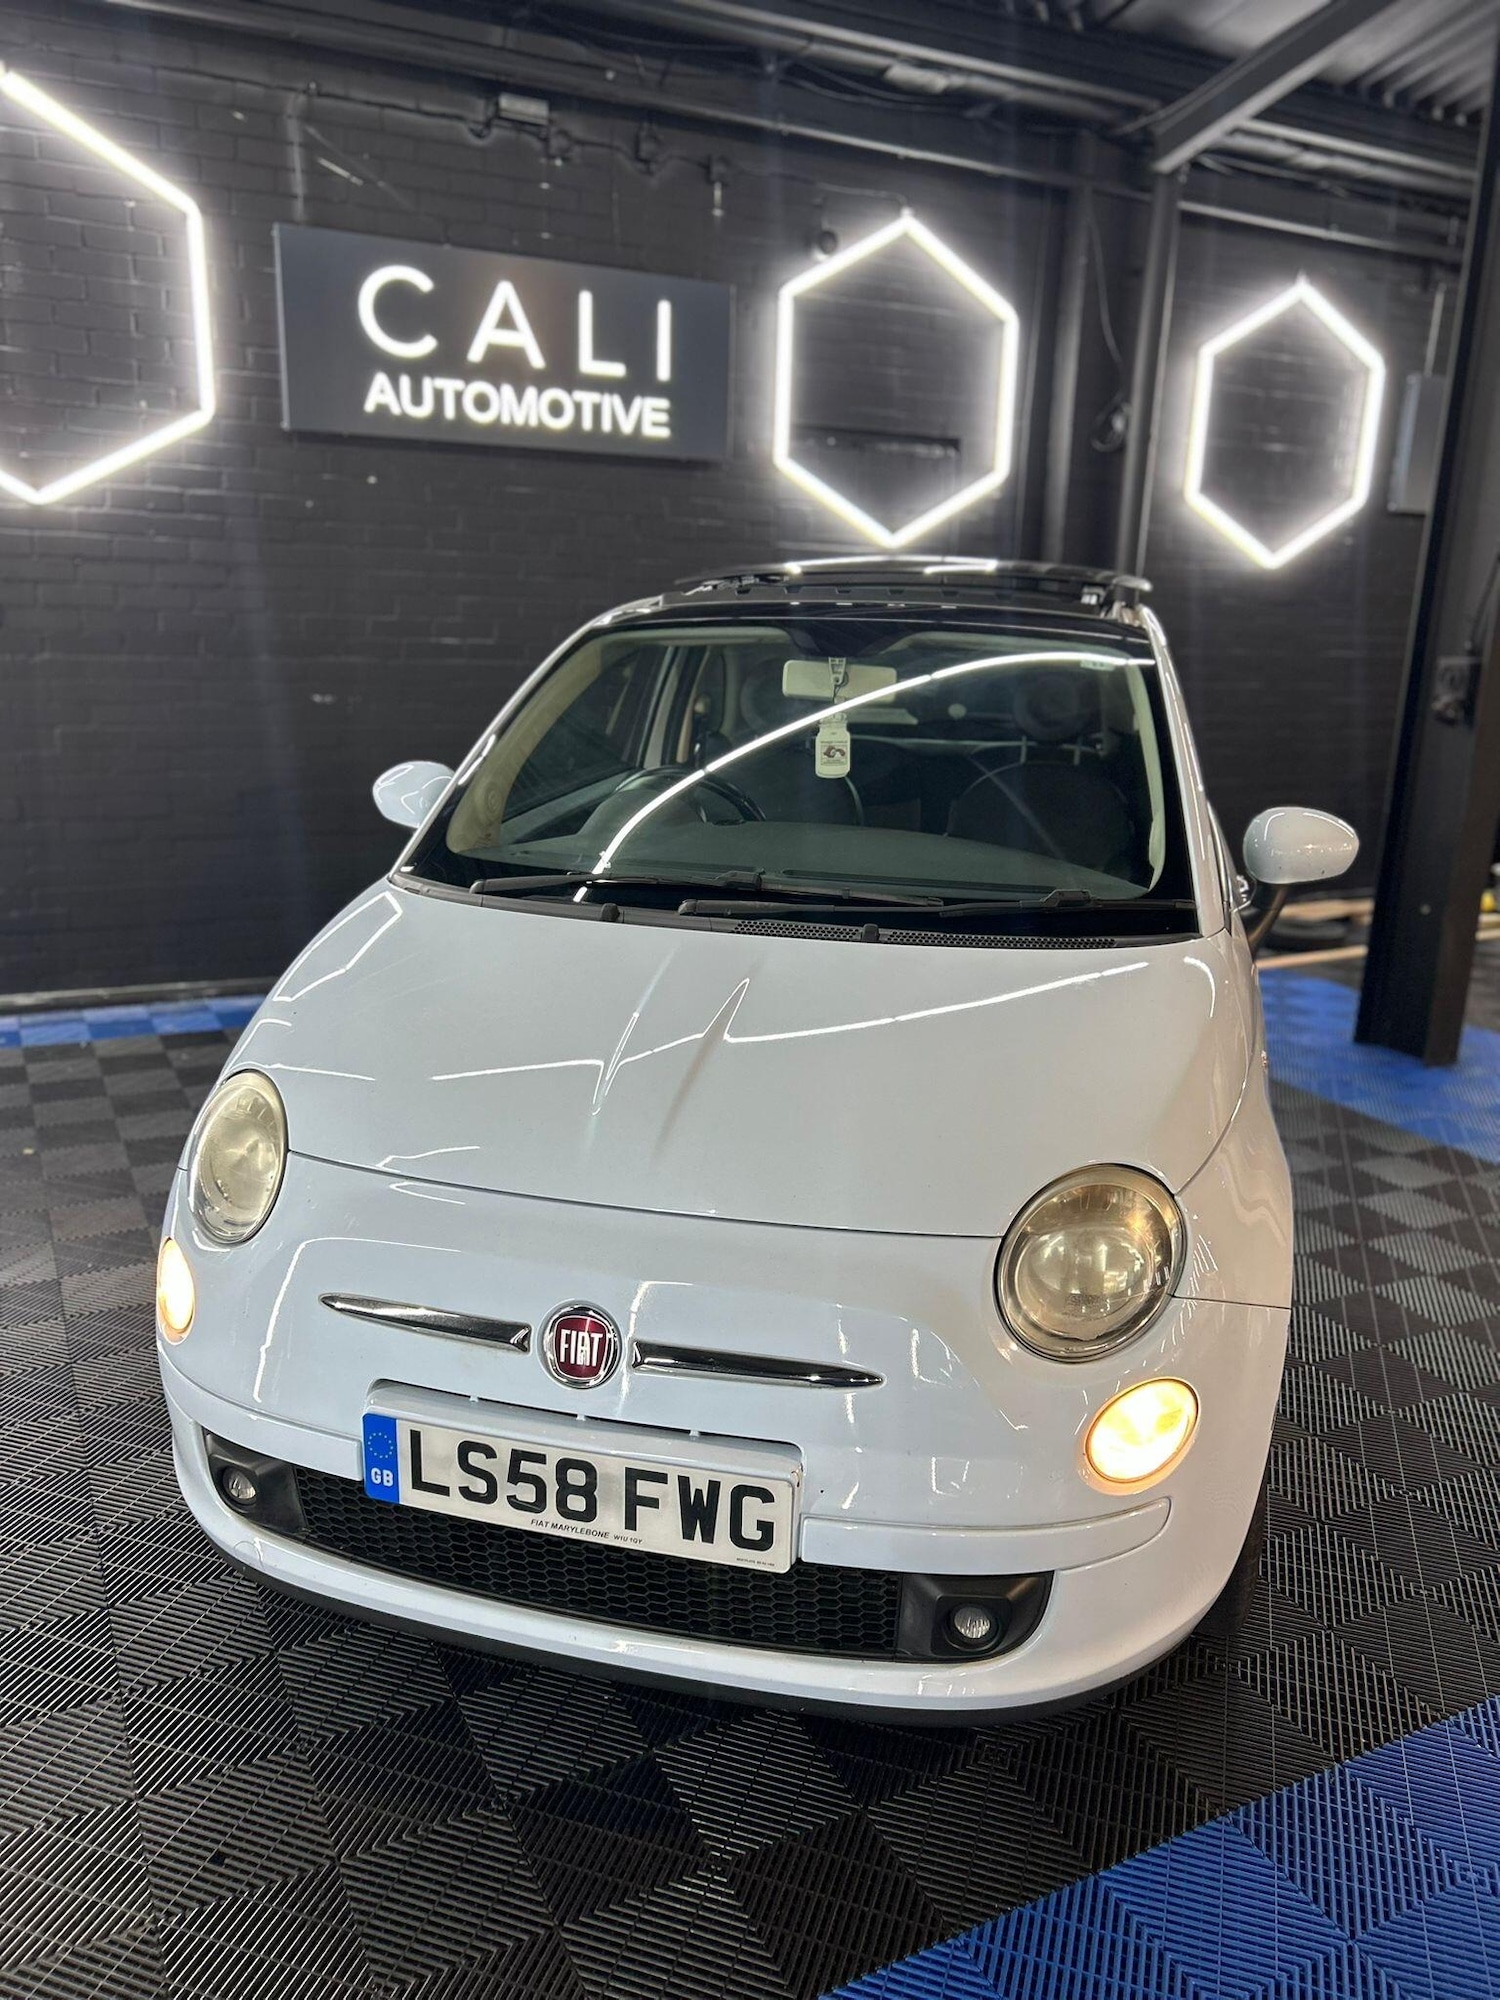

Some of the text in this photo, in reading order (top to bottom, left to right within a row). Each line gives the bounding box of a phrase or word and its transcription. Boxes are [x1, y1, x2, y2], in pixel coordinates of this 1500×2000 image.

[358, 264, 672, 382] CALI
[363, 371, 672, 438] AUTOMOTIVE
[559, 1328, 603, 1367] FIAT
[370, 1467, 394, 1487] GB
[409, 1429, 775, 1551] LS58 FWG
[530, 1518, 550, 1529] FIAT
[550, 1522, 610, 1539] MARYLEBONE
